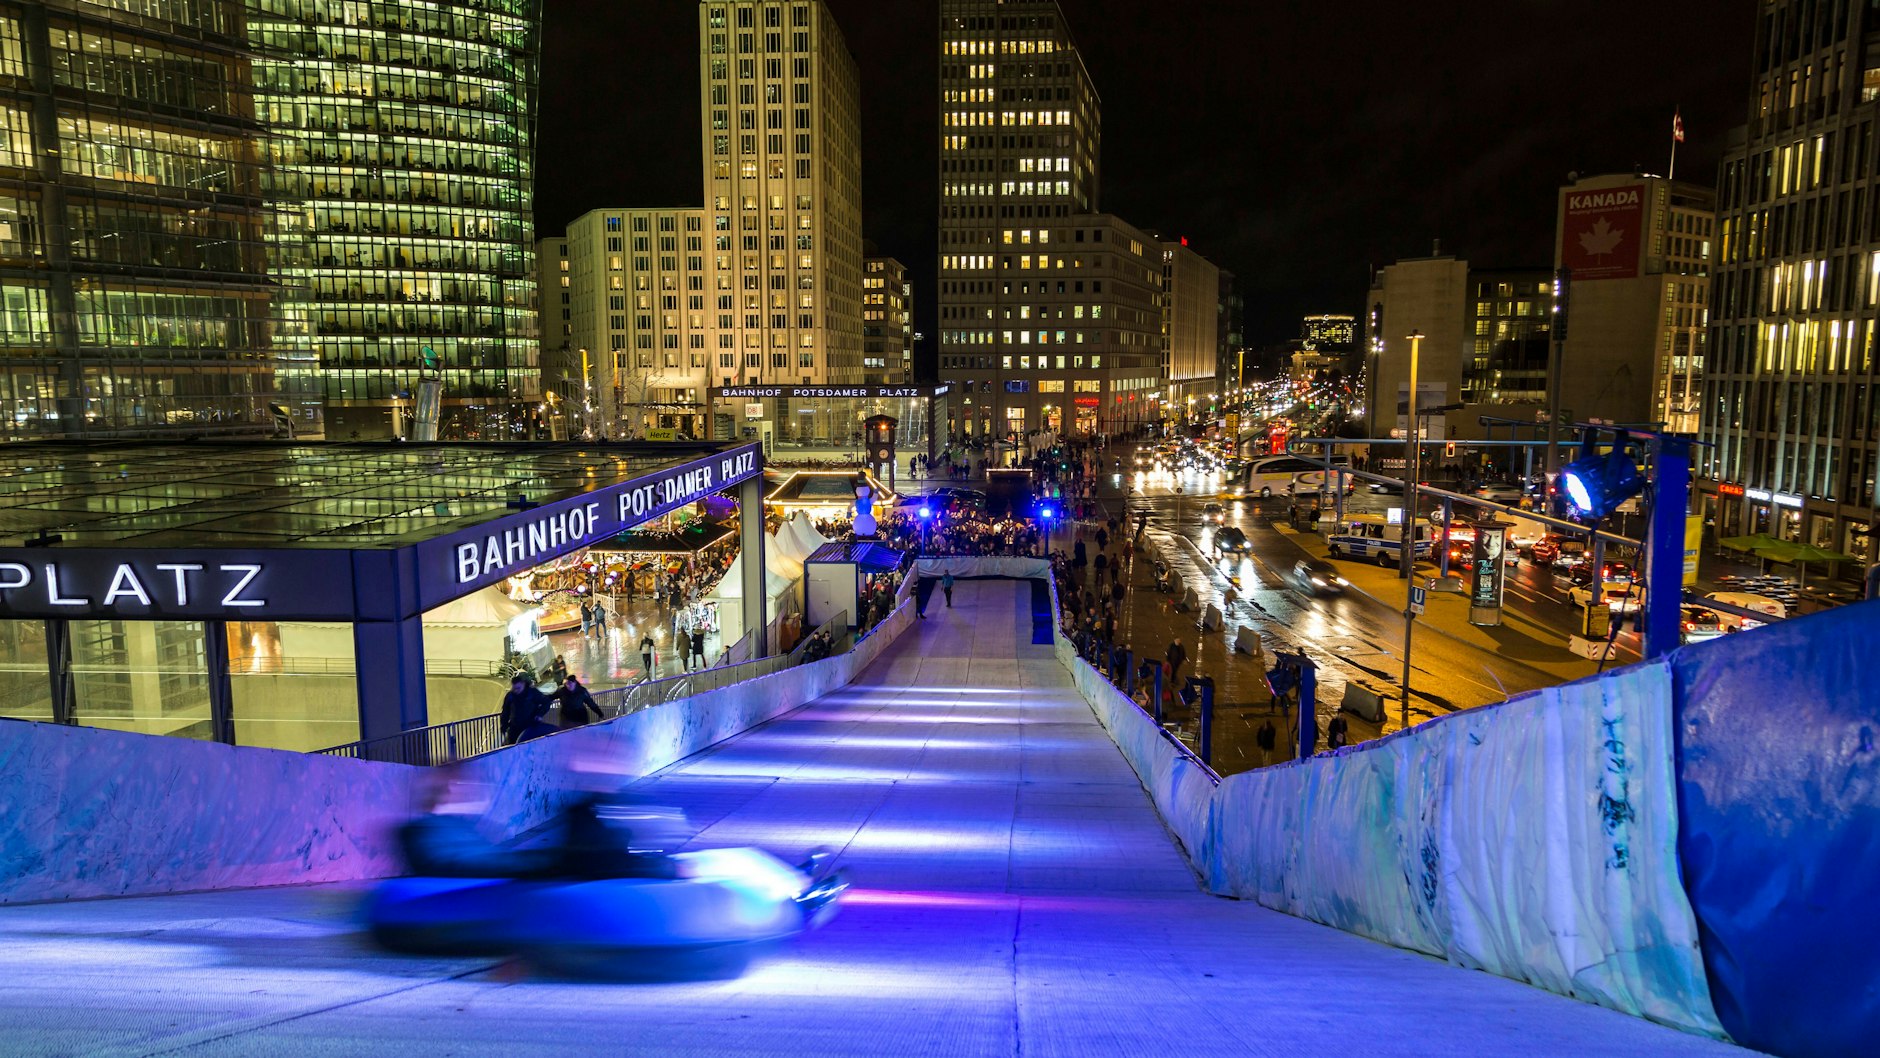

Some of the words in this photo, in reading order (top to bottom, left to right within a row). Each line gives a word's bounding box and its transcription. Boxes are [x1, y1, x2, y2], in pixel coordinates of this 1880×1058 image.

[1569, 191, 1639, 209] KANADA
[722, 388, 782, 397] BAHNHOF
[793, 388, 867, 397] POTSDAMER
[879, 388, 918, 397] PLATZ
[458, 503, 599, 583] BAHNHOF
[619, 466, 712, 521] POTSDAMER
[722, 452, 754, 481] PLATZ
[1414, 589, 1423, 603] U
